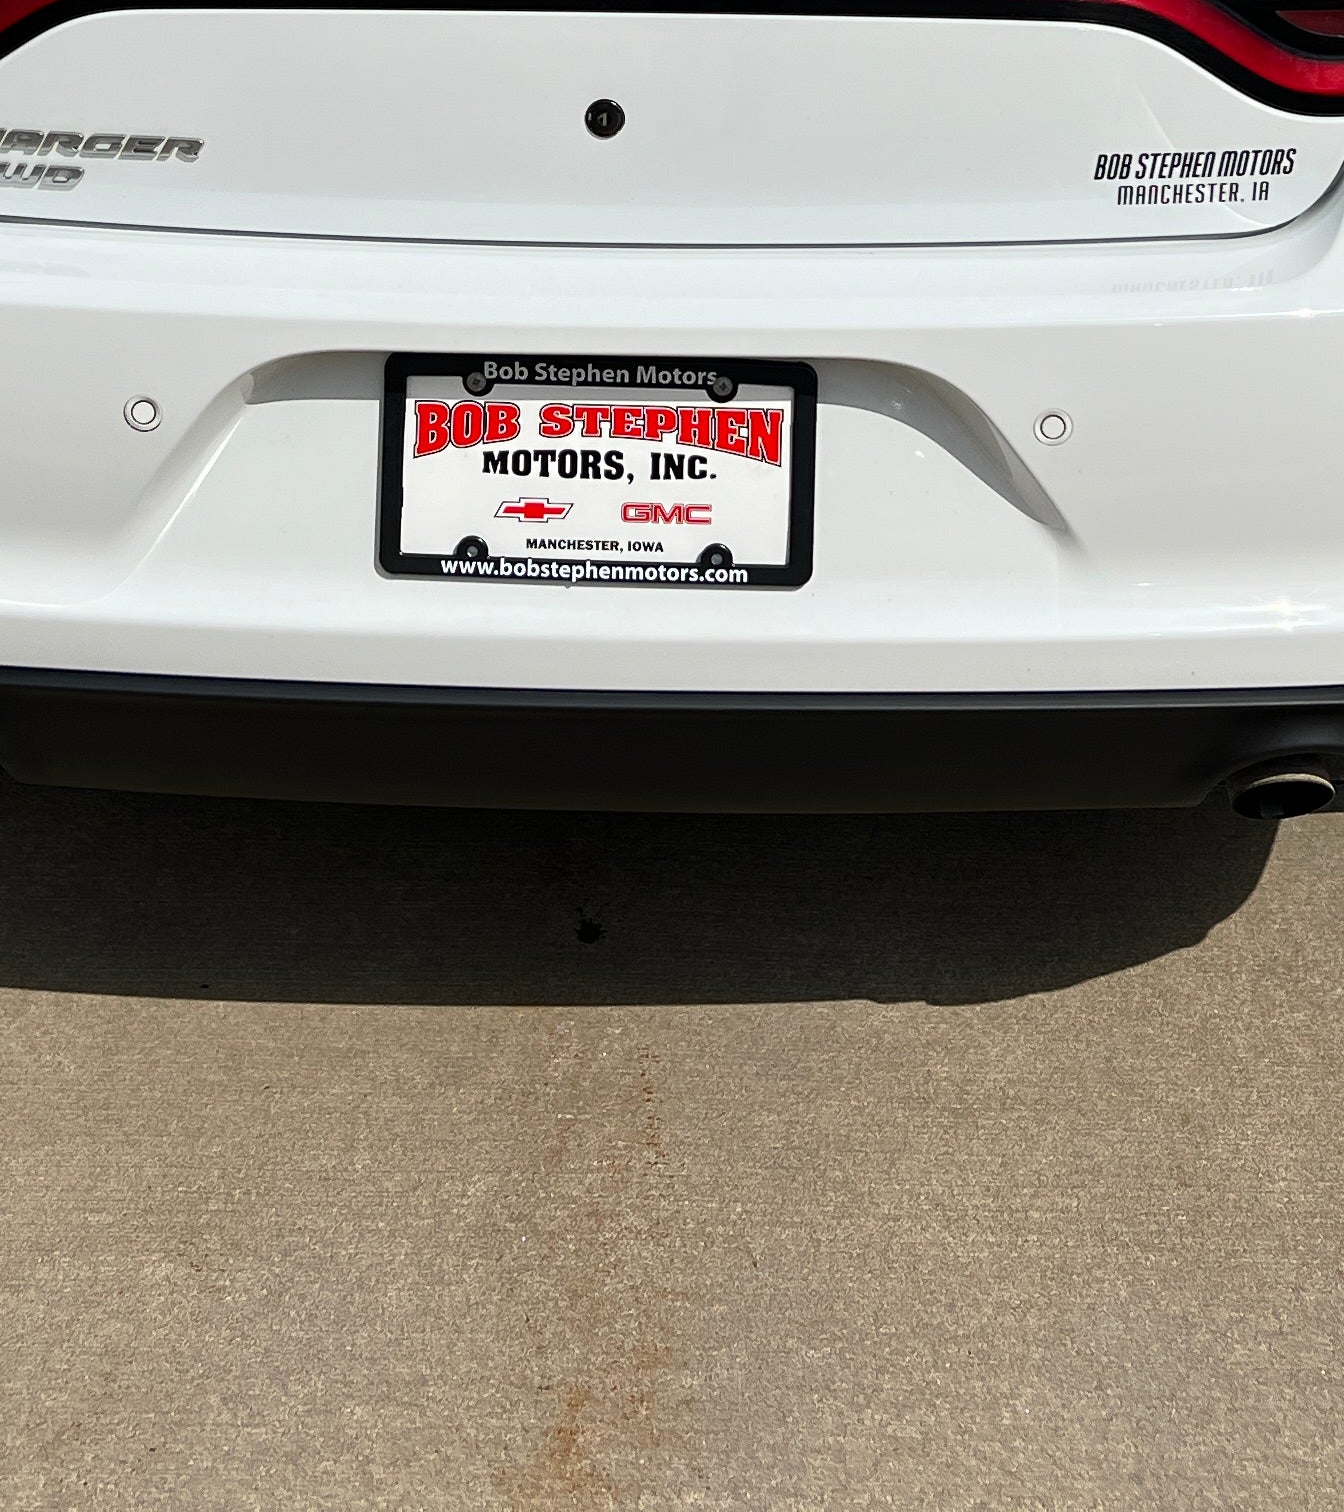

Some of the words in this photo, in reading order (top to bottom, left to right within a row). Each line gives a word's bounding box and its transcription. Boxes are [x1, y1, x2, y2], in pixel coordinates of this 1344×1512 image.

[1094, 153, 1133, 180] BOB
[1134, 151, 1216, 180] STEPHEN
[1217, 148, 1297, 177] MOTORS
[1251, 181, 1270, 201] IA
[483, 360, 529, 382] Bob
[534, 362, 630, 386] Stephen
[636, 365, 718, 386] Motors
[413, 399, 521, 459] BOB
[539, 402, 784, 467] STEPHEN
[482, 449, 635, 485] MOTORS,
[650, 453, 717, 480] INC.
[620, 501, 712, 525] GMC
[526, 538, 623, 553] MANCHESTER,
[627, 541, 664, 553] IOWA
[441, 557, 749, 584] www.bobstephenmotors.com
